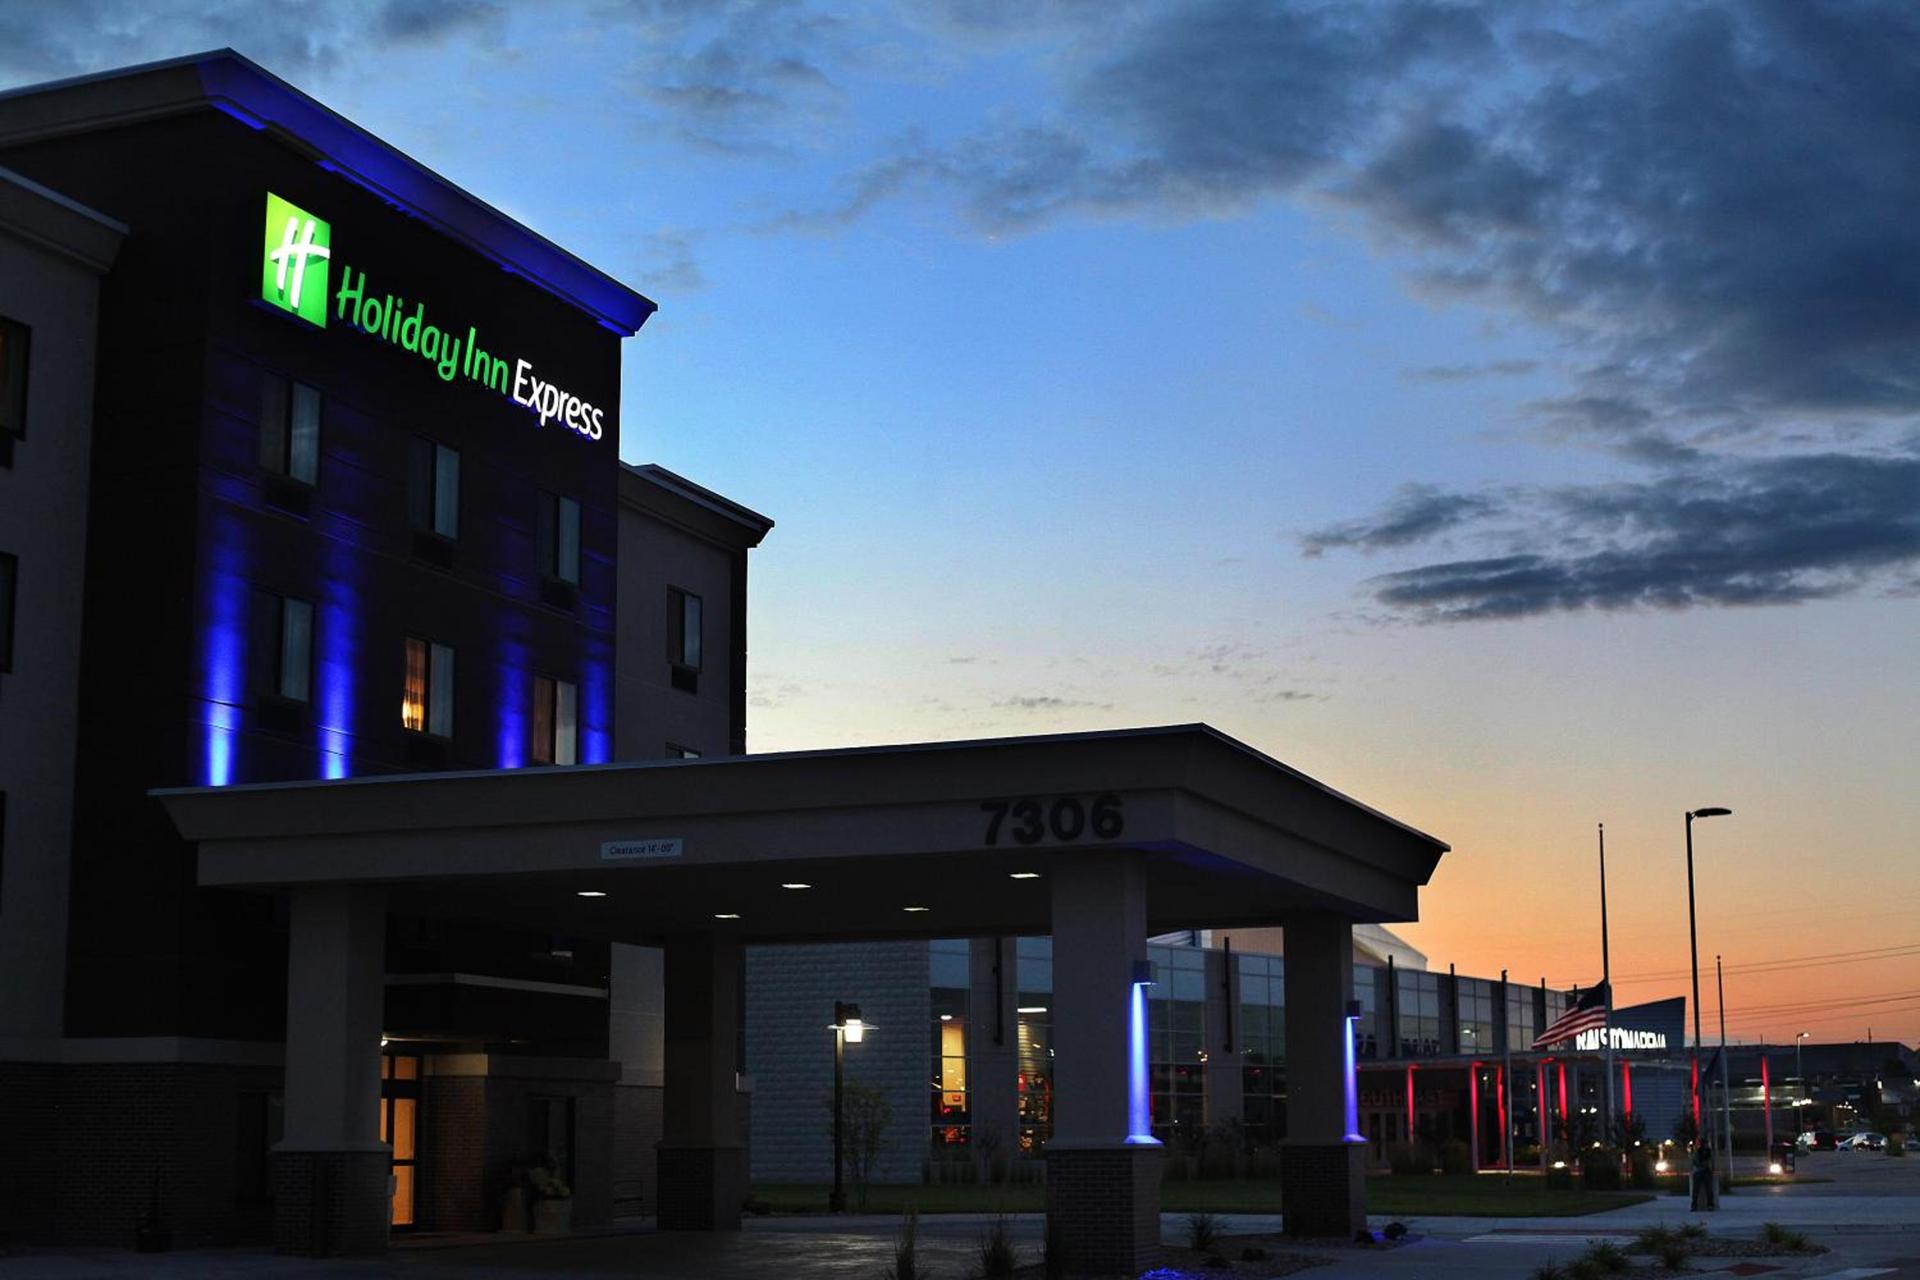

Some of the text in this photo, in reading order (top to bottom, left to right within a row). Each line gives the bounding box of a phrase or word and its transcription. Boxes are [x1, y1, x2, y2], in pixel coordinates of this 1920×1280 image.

[336, 265, 604, 441] Holiday Inn Express
[980, 794, 1124, 846] 7306
